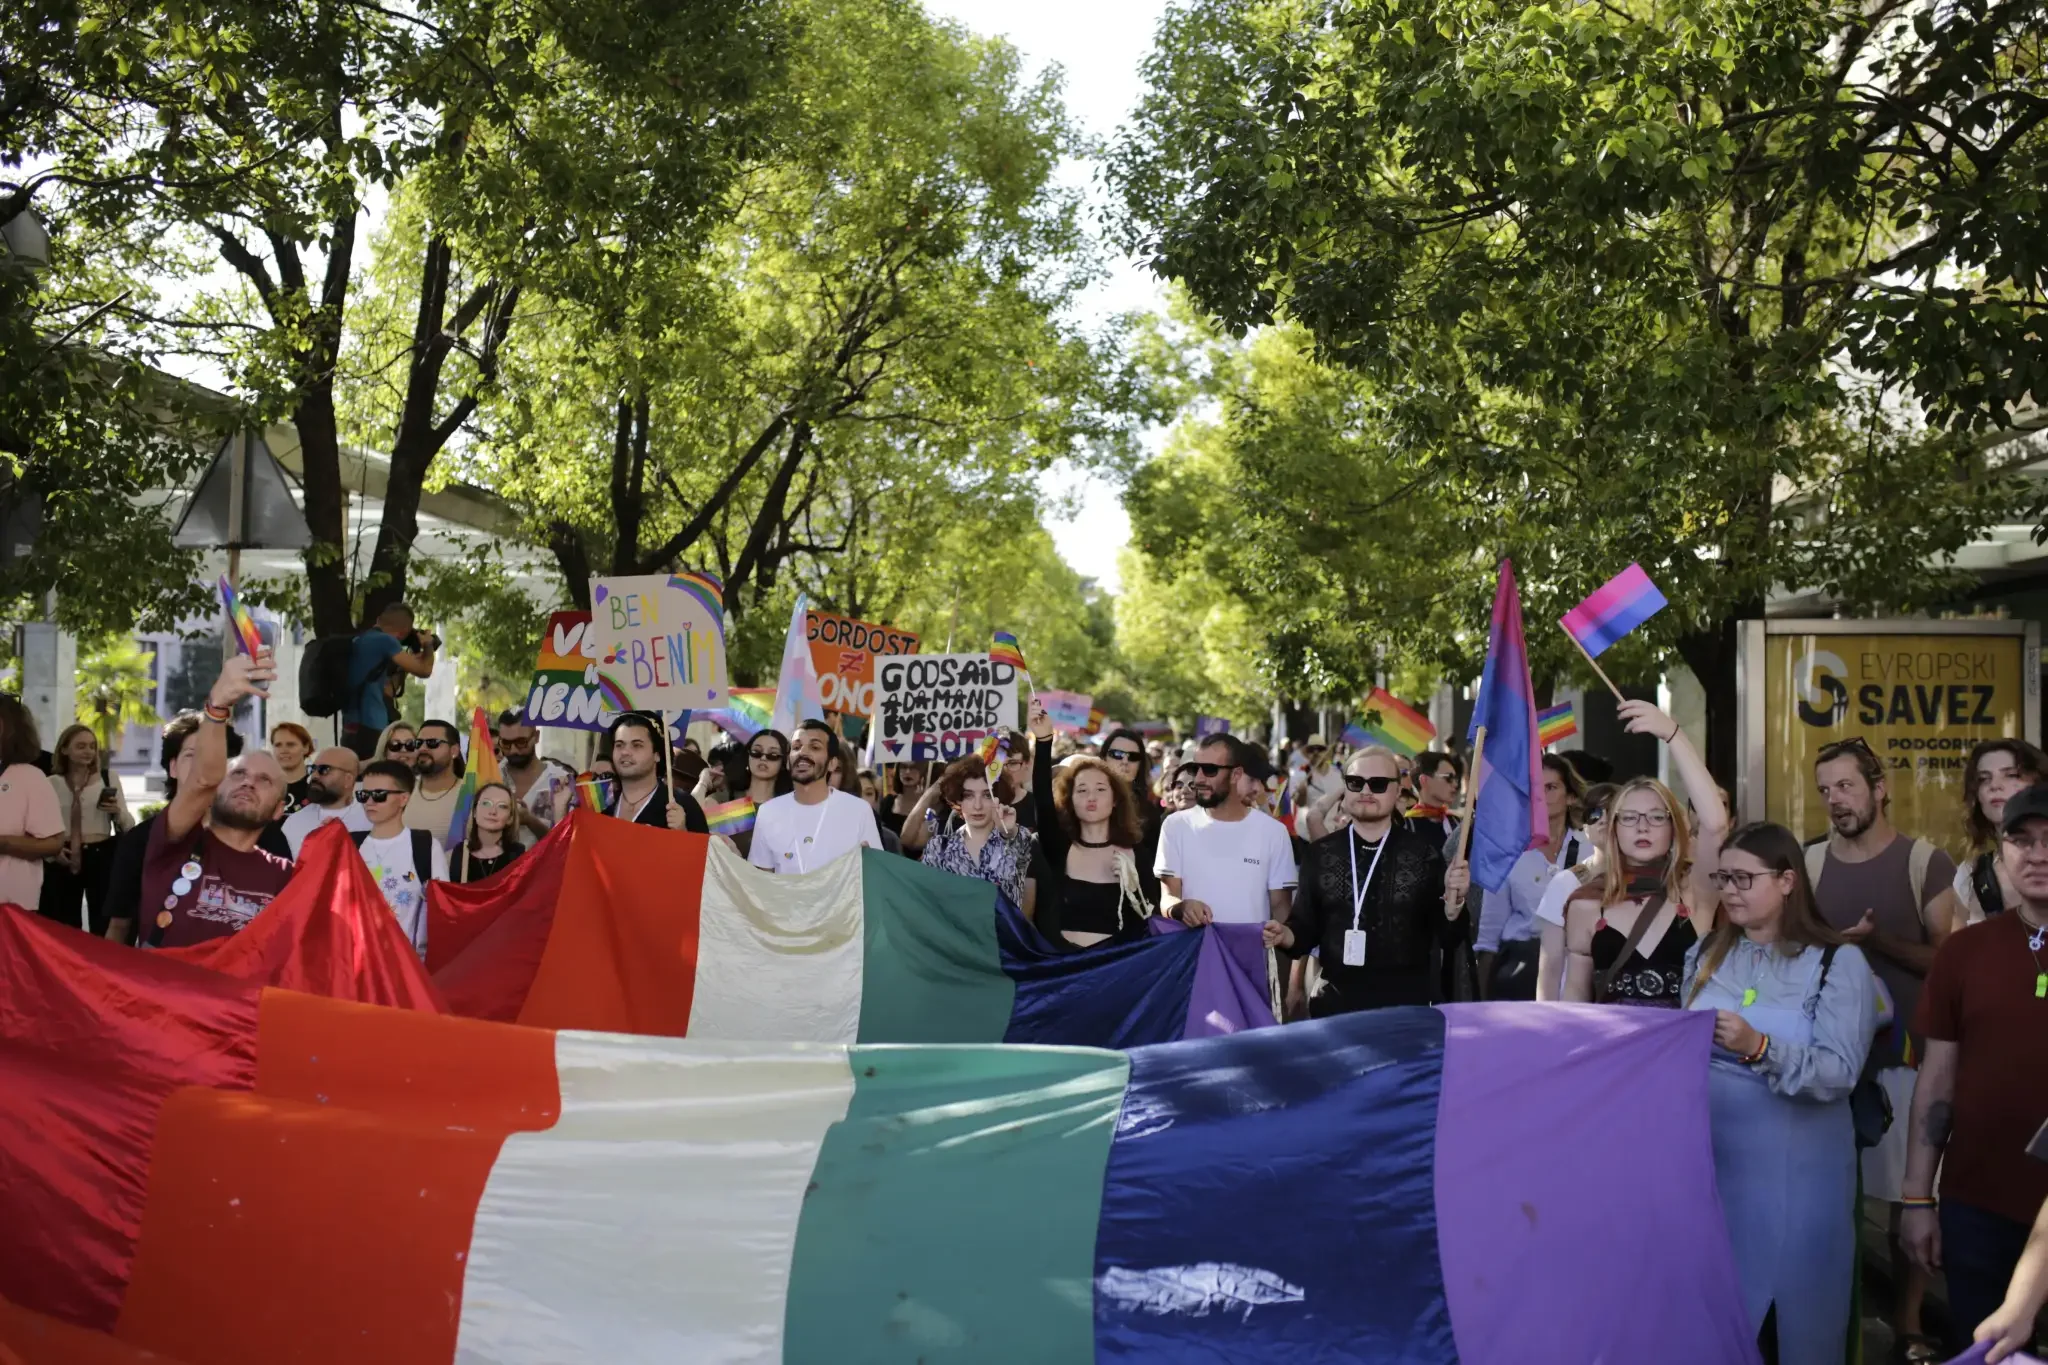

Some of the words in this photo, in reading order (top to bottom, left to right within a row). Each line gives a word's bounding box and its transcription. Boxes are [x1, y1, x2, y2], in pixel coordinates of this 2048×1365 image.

[610, 591, 658, 630] BEN
[806, 614, 916, 655] GORDOST
[1860, 652, 1995, 680] EVROPSKI
[1859, 684, 1996, 725] SAVEZ
[911, 727, 996, 763] BOT
[1888, 757, 1911, 769] ZA
